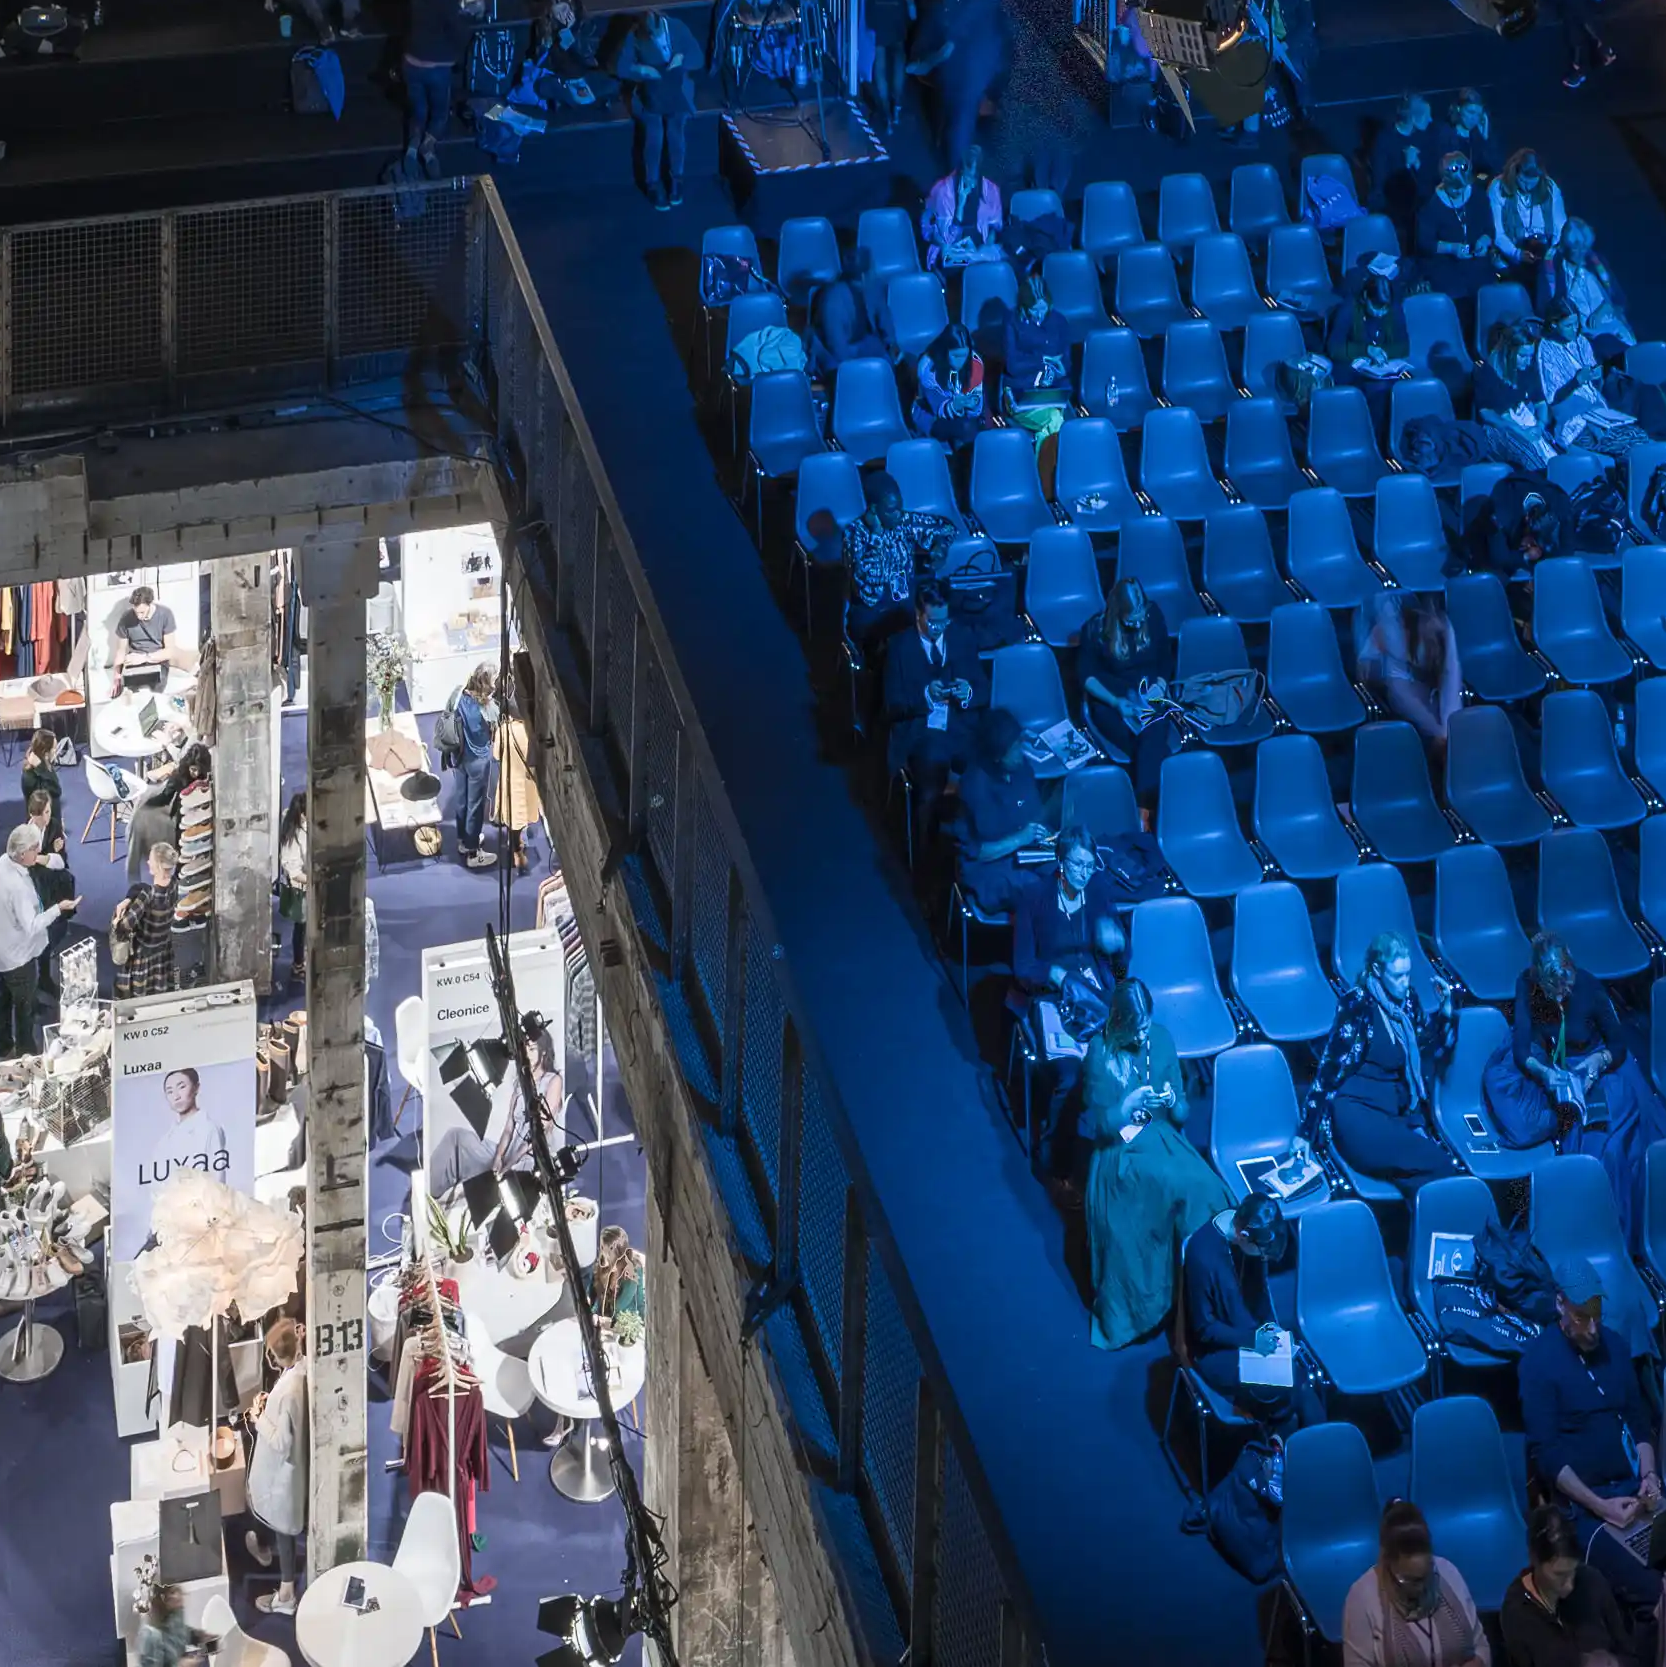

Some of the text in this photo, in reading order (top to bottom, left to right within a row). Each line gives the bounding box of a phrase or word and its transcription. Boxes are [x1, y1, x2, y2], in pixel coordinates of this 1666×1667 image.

[463, 972, 480, 982] C54
[437, 1003, 490, 1021] Cleonice
[151, 1026, 169, 1037] C52
[123, 1060, 162, 1075] Luxaa
